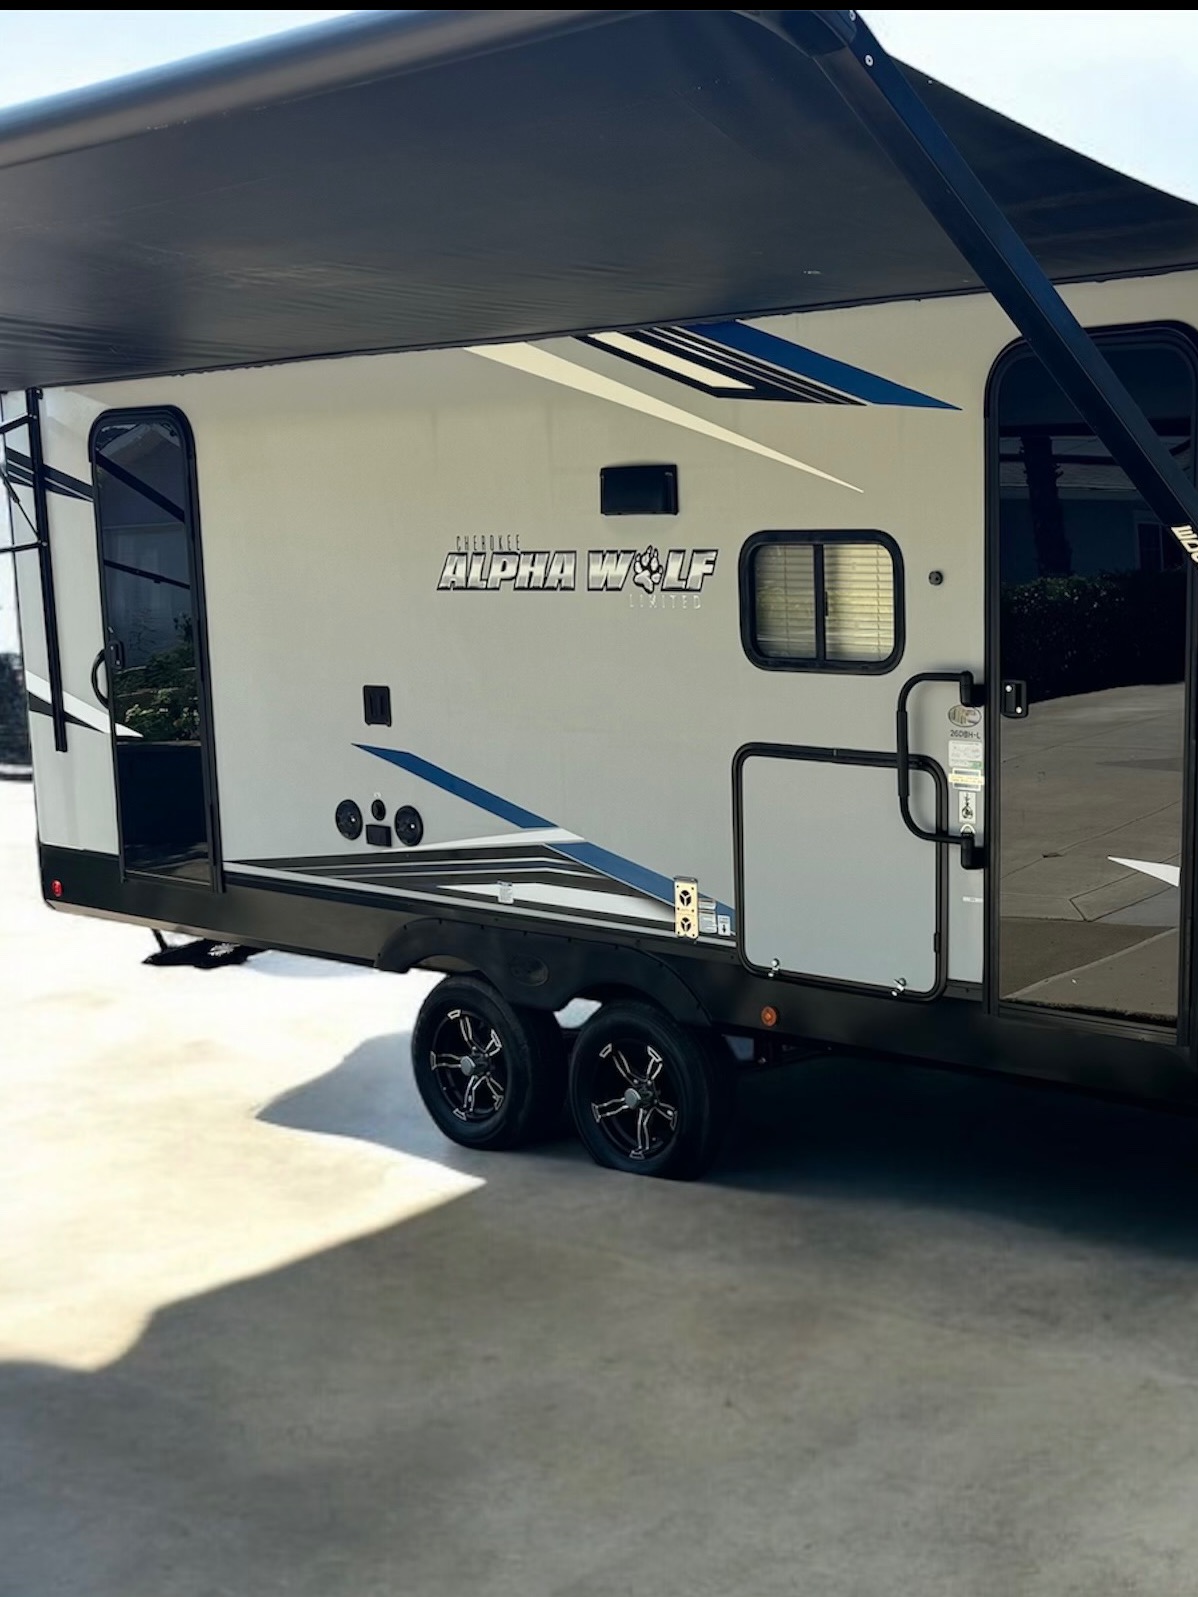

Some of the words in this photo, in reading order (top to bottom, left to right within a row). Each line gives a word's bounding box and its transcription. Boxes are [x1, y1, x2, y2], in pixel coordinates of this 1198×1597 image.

[456, 534, 521, 551] CHEROKEE
[437, 550, 577, 591] ALPHA
[629, 594, 702, 609] LIMITED
